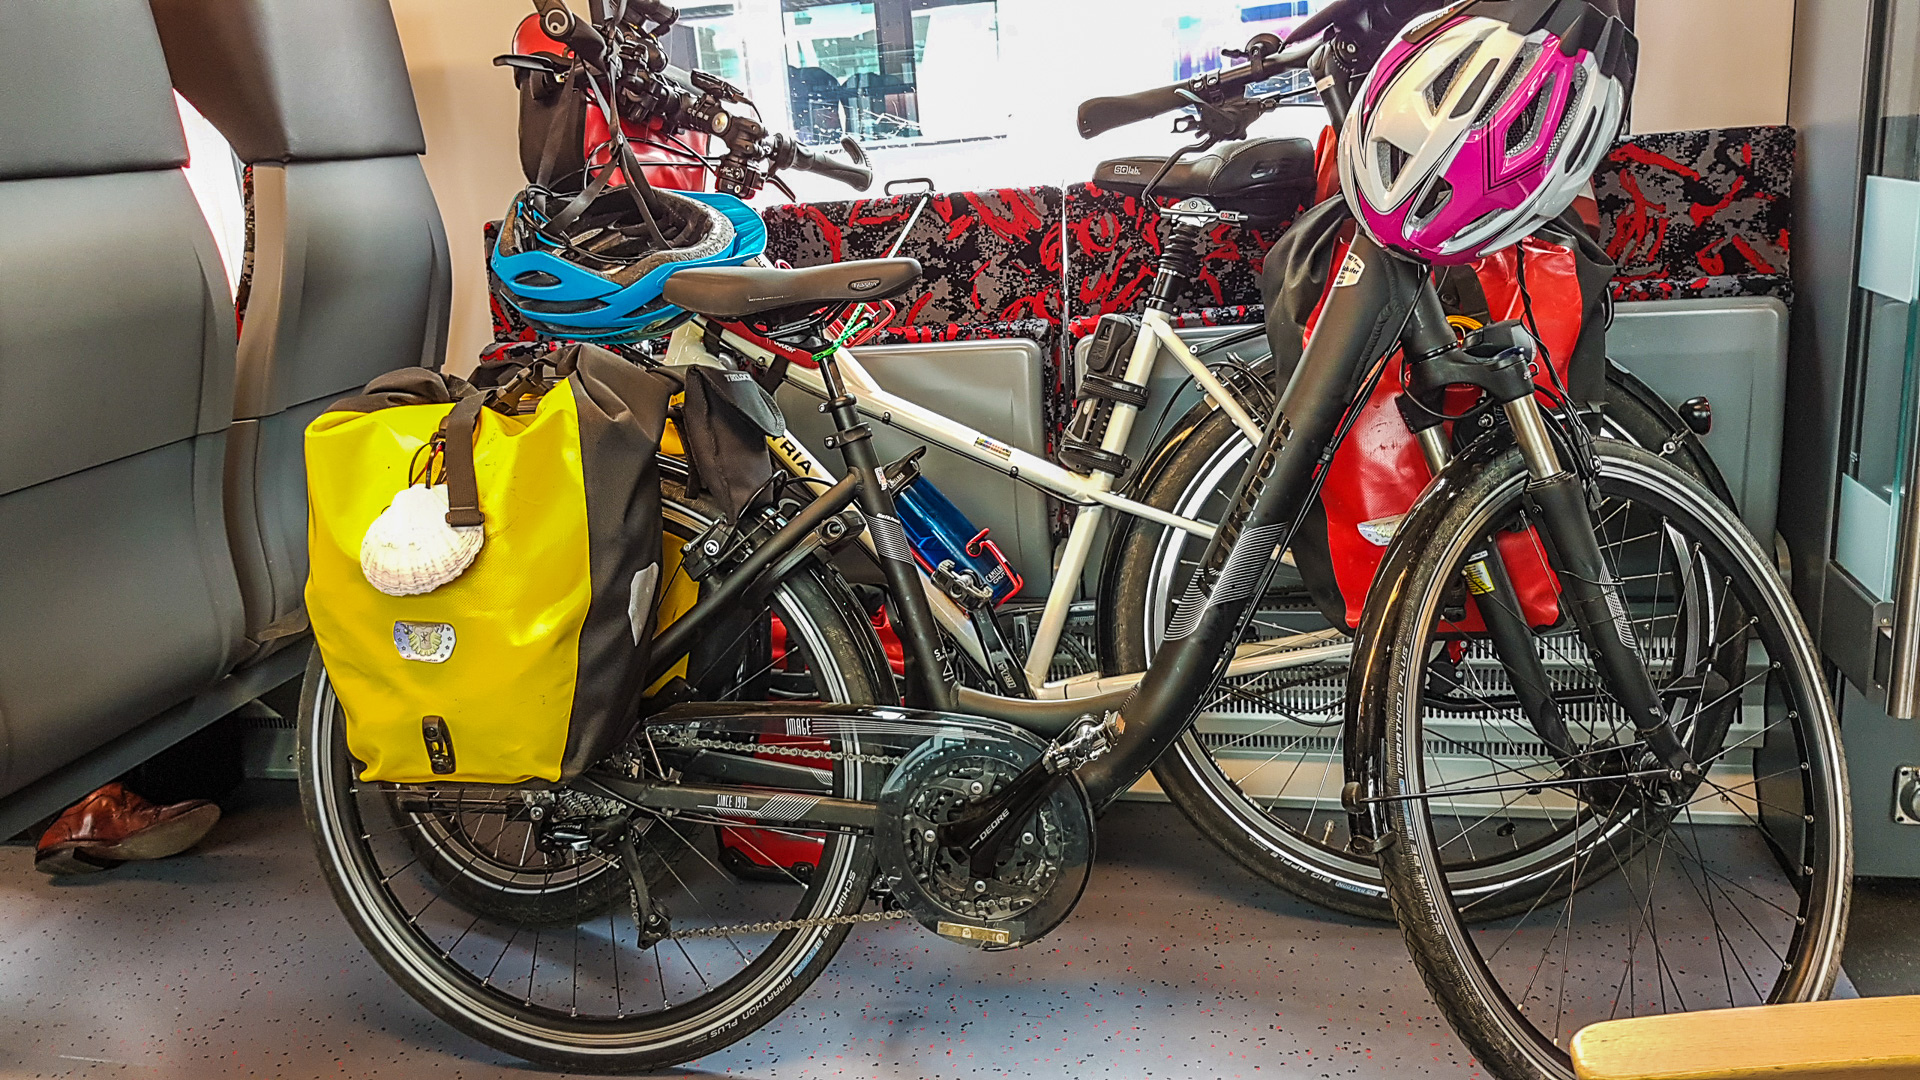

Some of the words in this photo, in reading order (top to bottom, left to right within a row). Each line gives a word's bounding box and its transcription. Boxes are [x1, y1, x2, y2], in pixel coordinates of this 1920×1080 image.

[1198, 410, 1294, 600] Kalkhoff
[993, 571, 1006, 585] CHUT
[1398, 645, 1409, 687] PLUS
[785, 717, 812, 736] IMAGE
[1396, 691, 1404, 776] MARATHON
[716, 793, 733, 808] SINCE
[735, 795, 748, 809] 1919
[979, 807, 1010, 842] DEORE
[1410, 843, 1445, 936] SCHWALBE
[741, 975, 793, 1020] MARATHON
[709, 1018, 739, 1039] PLUS
